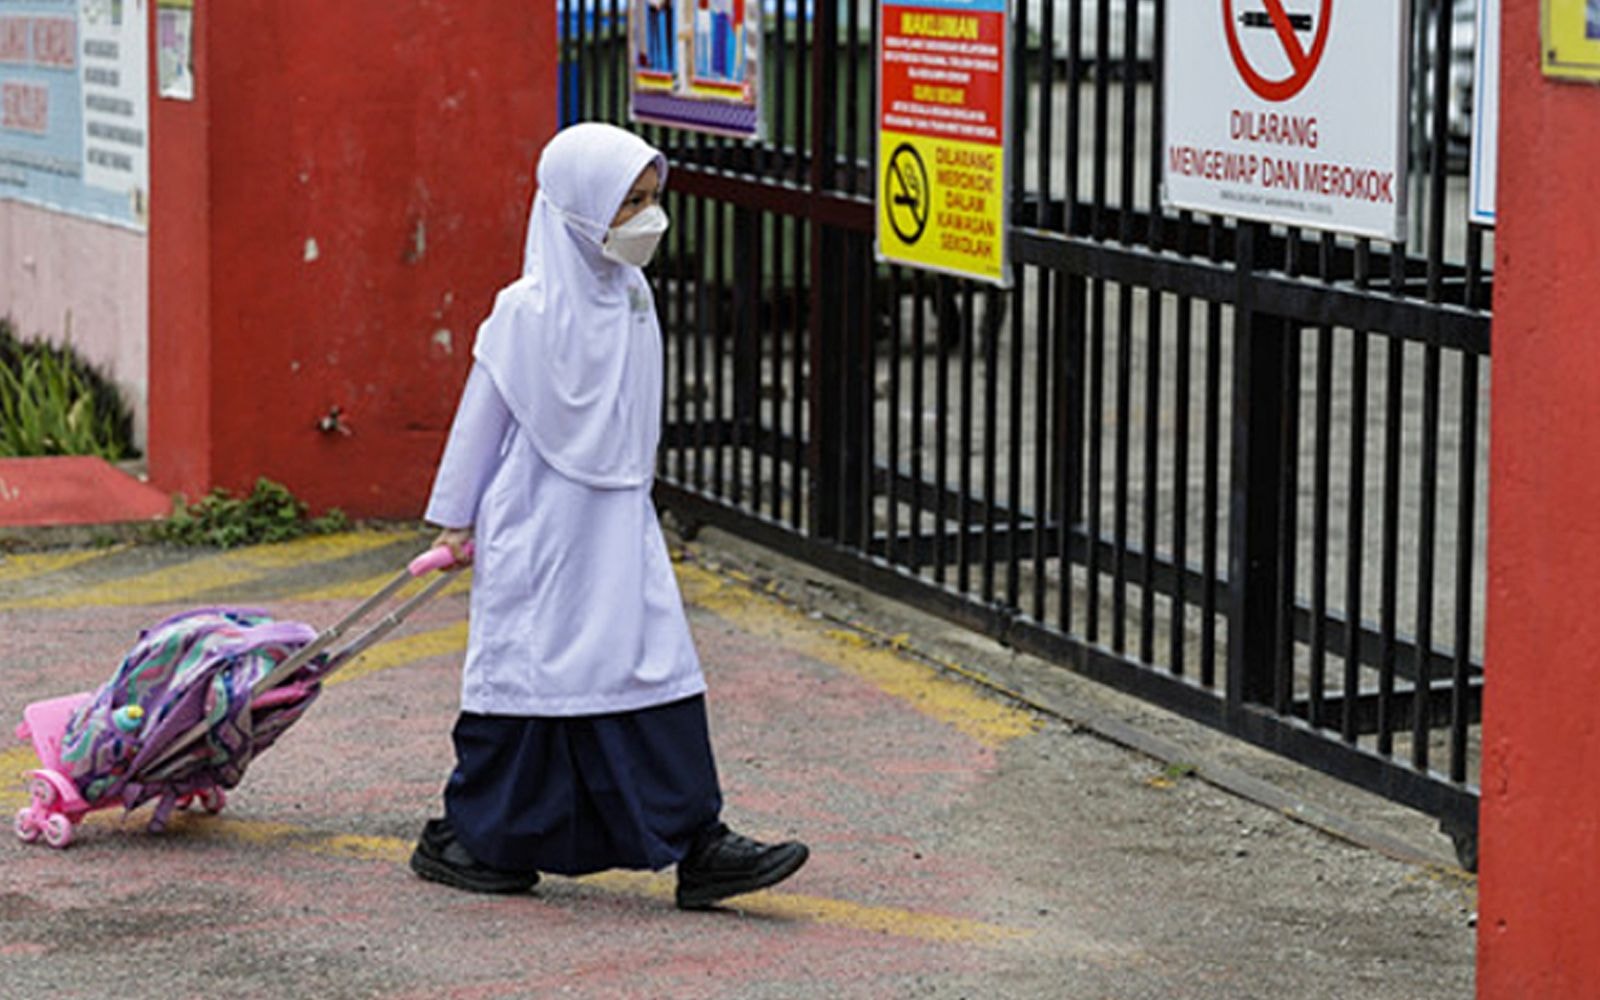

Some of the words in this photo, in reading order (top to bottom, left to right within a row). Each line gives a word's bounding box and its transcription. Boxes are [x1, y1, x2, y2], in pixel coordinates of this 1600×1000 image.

[1231, 110, 1318, 149] DILARANG
[936, 146, 994, 172] DILARANG
[936, 169, 994, 193] MEROKOK
[1170, 147, 1258, 184] MENGEWAP
[1262, 156, 1300, 191] DAN
[1304, 163, 1393, 203] MEROKOK
[945, 190, 985, 213] DALAM
[936, 211, 994, 236] KAWASAN
[940, 231, 993, 257] SEKOLAH
